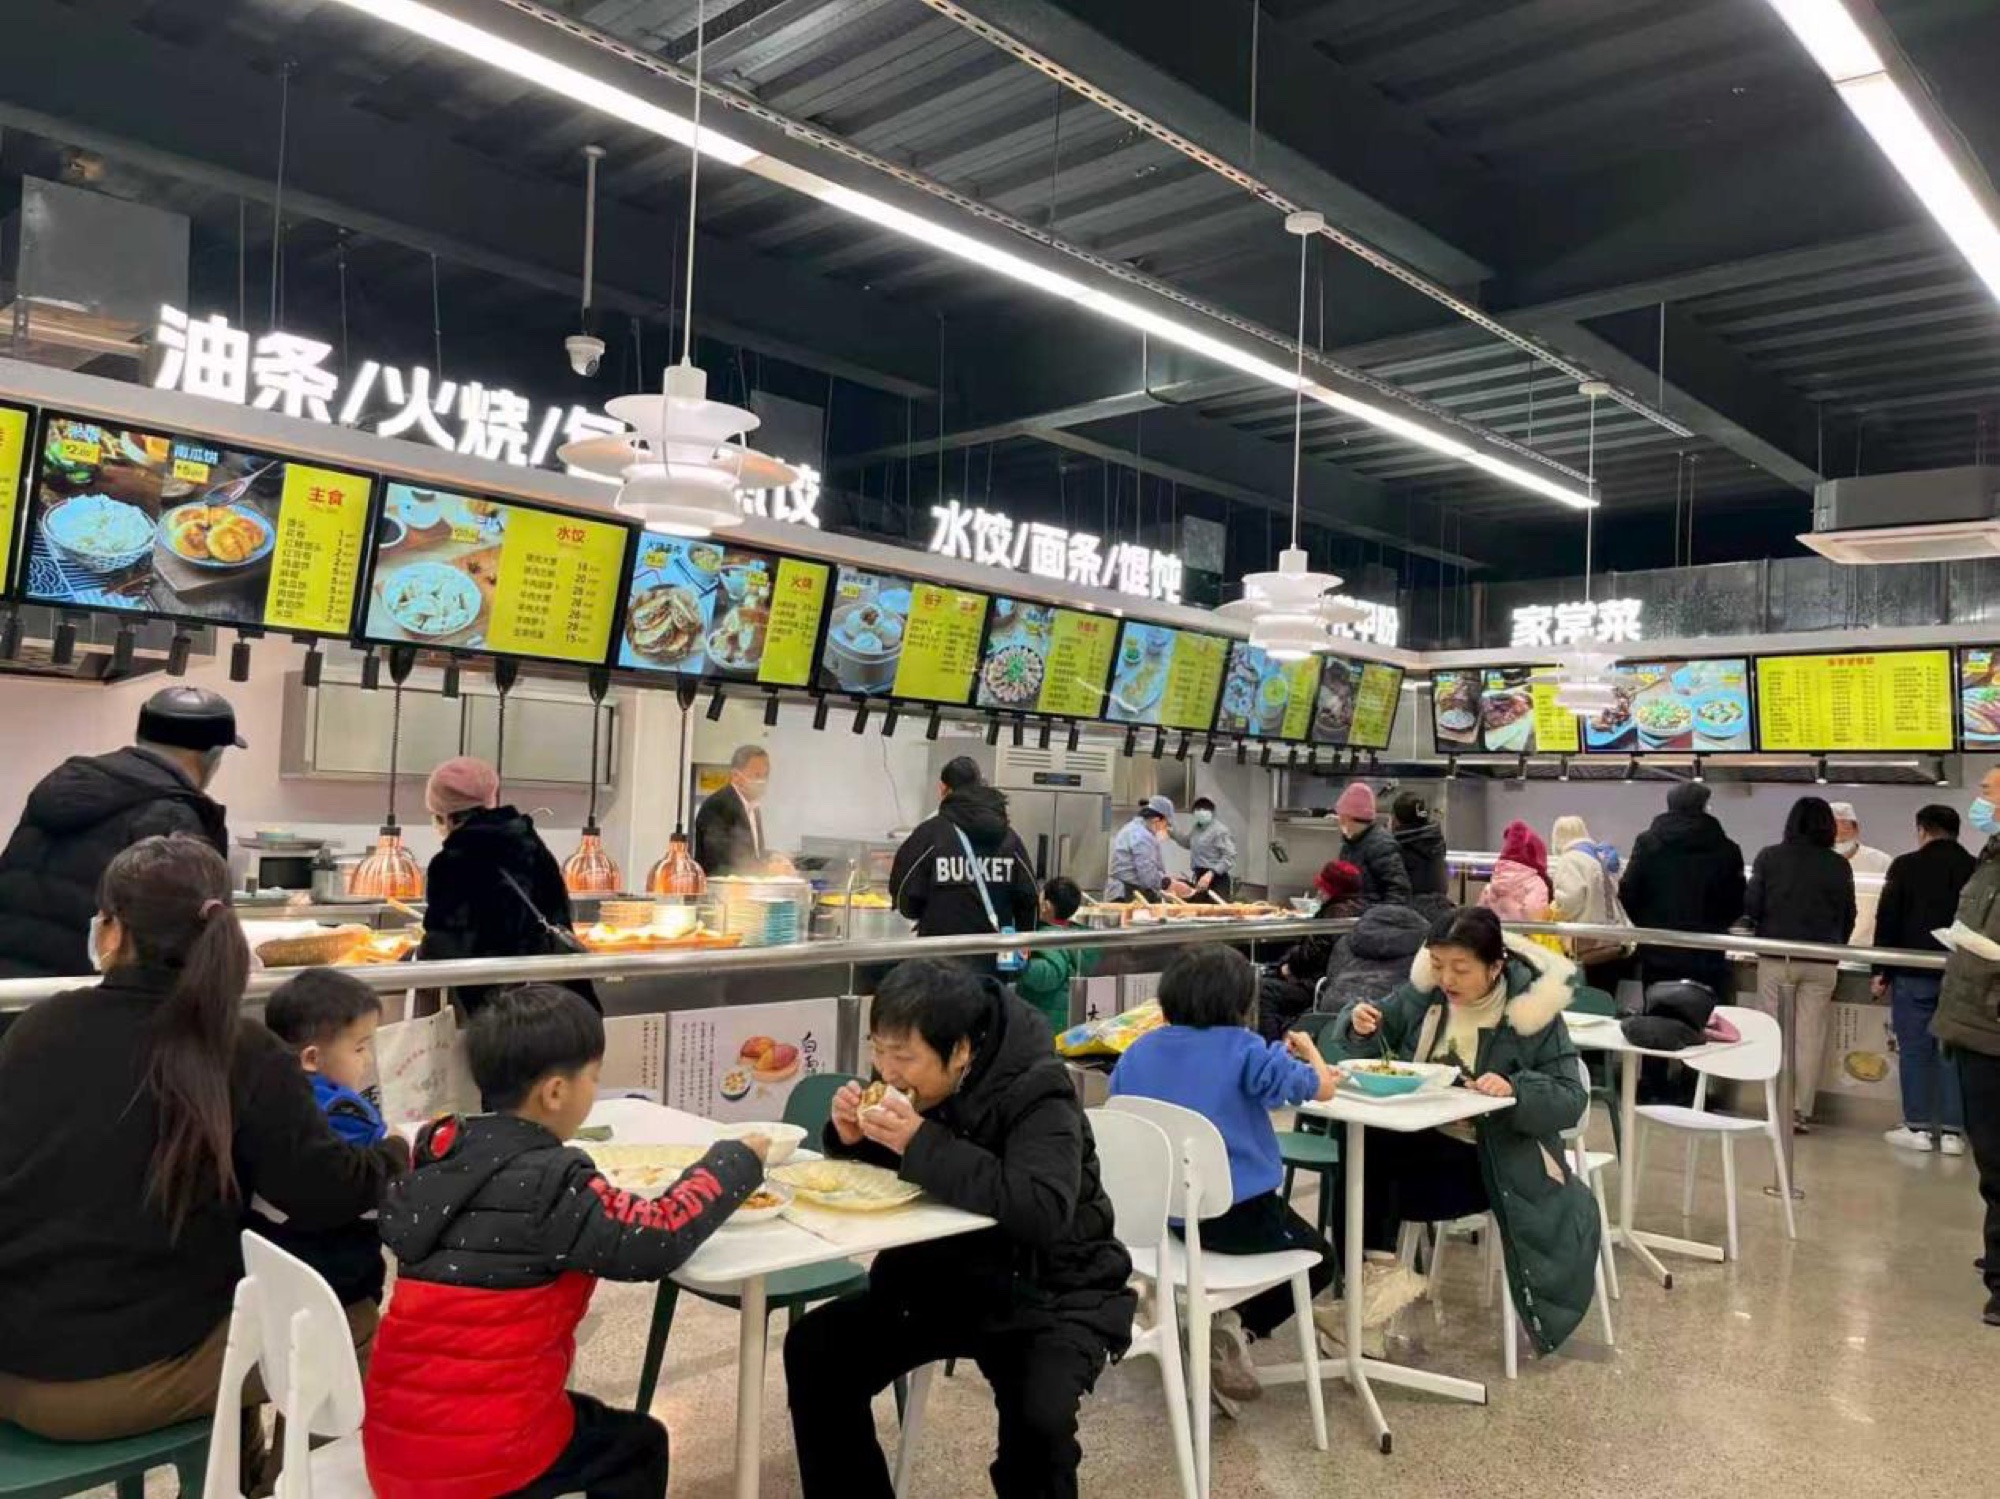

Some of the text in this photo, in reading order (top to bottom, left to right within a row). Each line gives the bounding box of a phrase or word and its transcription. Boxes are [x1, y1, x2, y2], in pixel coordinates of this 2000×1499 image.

[308, 485, 344, 505] 主食
[556, 526, 585, 543] 水饺
[930, 500, 1182, 603] 水饺/面条/馄饨
[1510, 598, 1643, 647] 家常菜
[936, 857, 1014, 882] BUCKET
